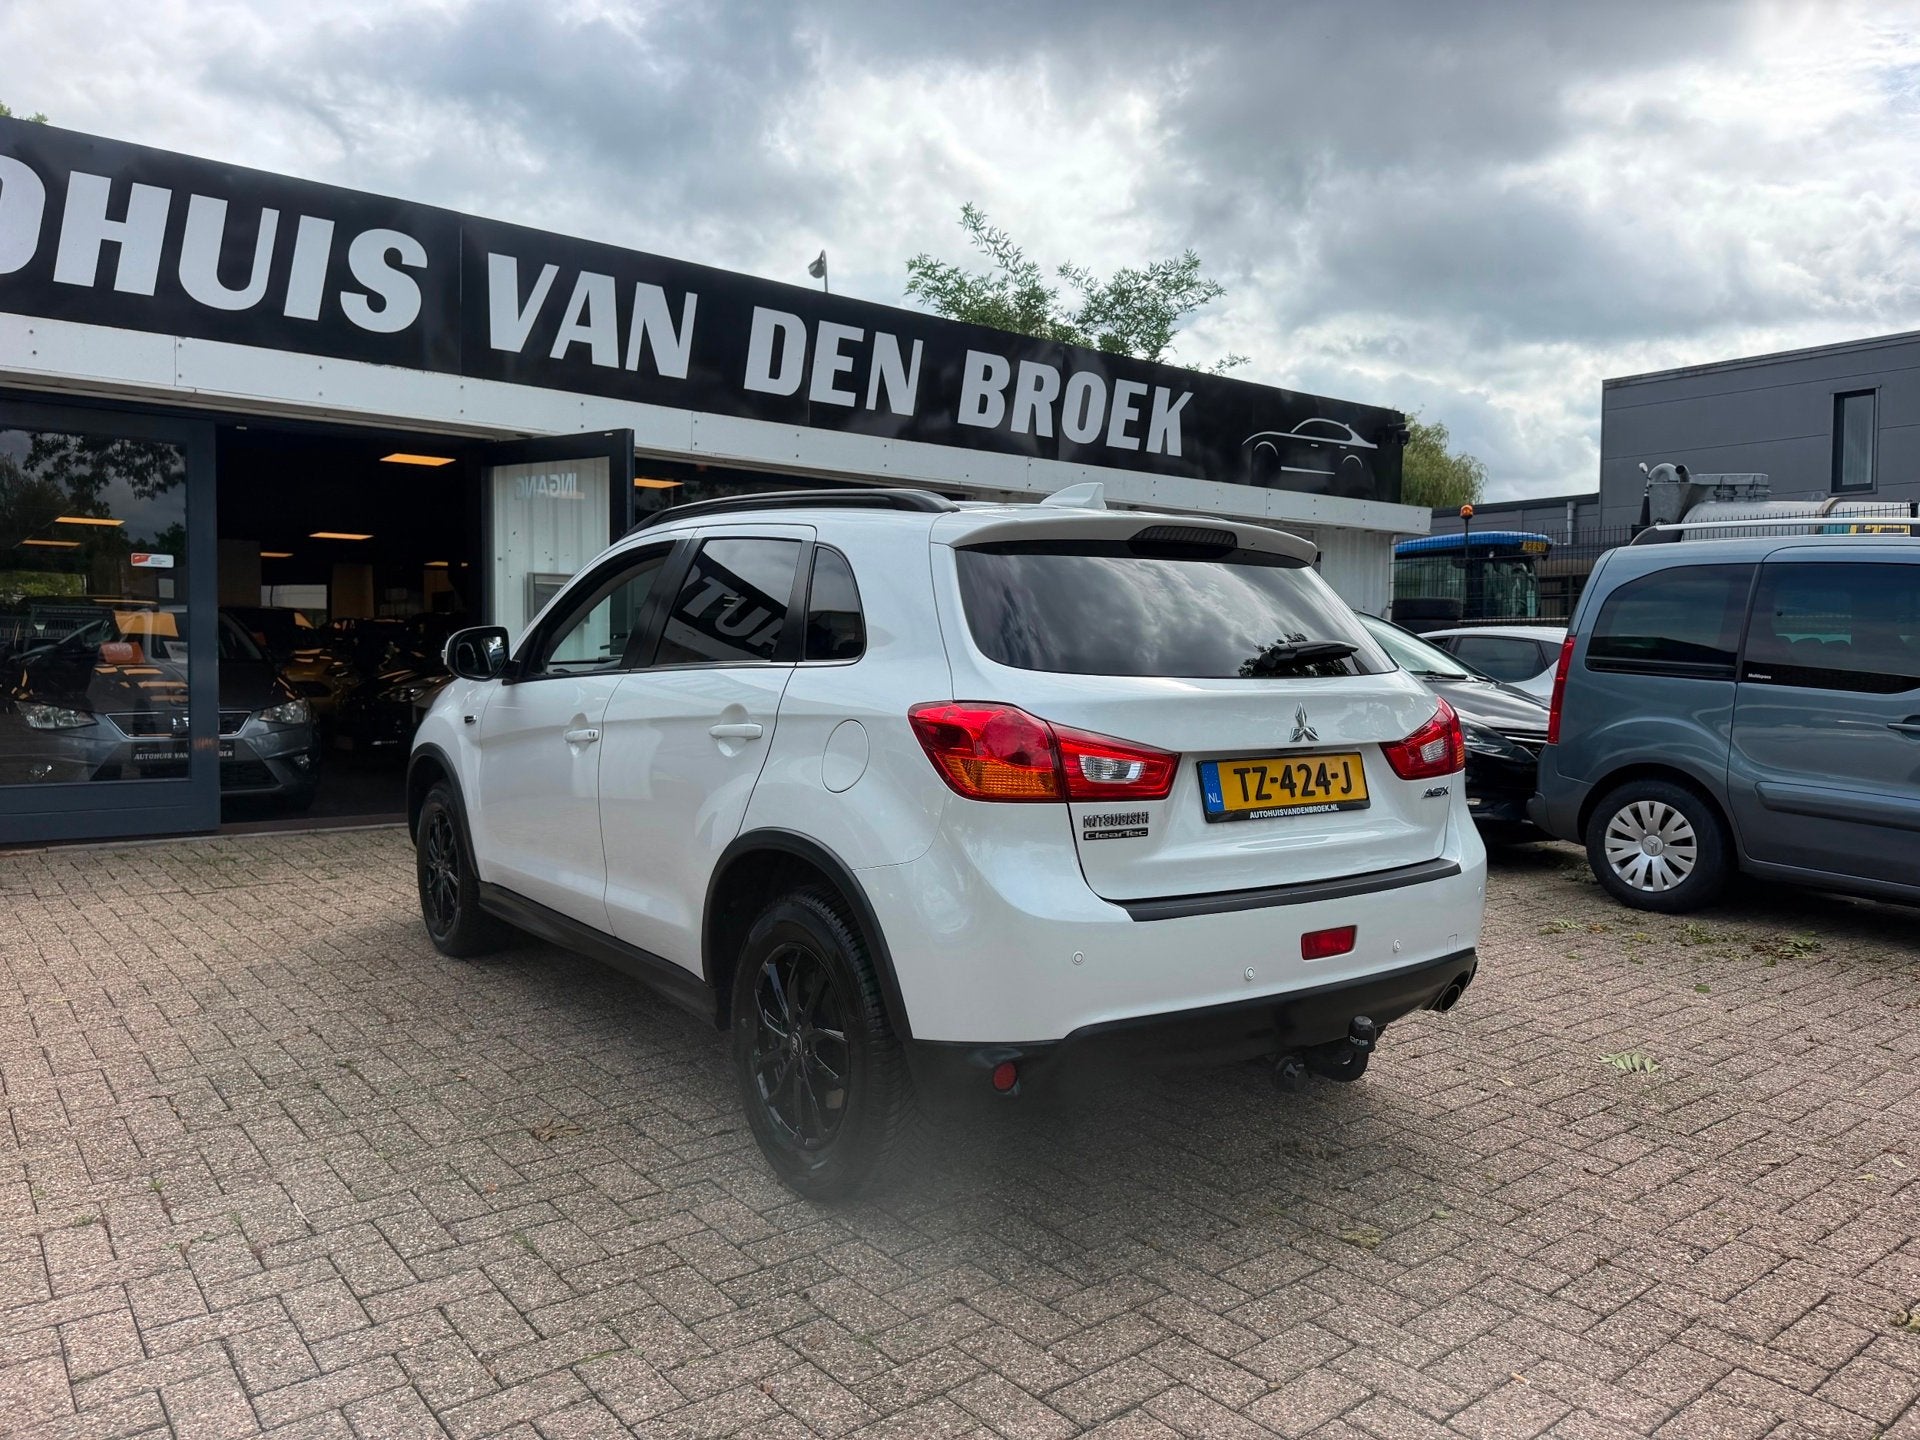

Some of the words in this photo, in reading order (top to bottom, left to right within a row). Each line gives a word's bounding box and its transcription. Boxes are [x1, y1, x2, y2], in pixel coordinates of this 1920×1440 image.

[487, 251, 698, 380] VAN
[743, 305, 923, 417] DEN
[957, 348, 1195, 457] BROEK
[134, 751, 172, 760] AUTOHUIS
[1233, 761, 1353, 802] TZ-424-J
[1208, 793, 1222, 803] NL
[1421, 785, 1449, 799] ASX
[1250, 803, 1340, 819] AUTOHUISVANDENBROEK.NL
[1083, 811, 1149, 828] MITSUBISHI
[1085, 830, 1148, 839] ClearTec
